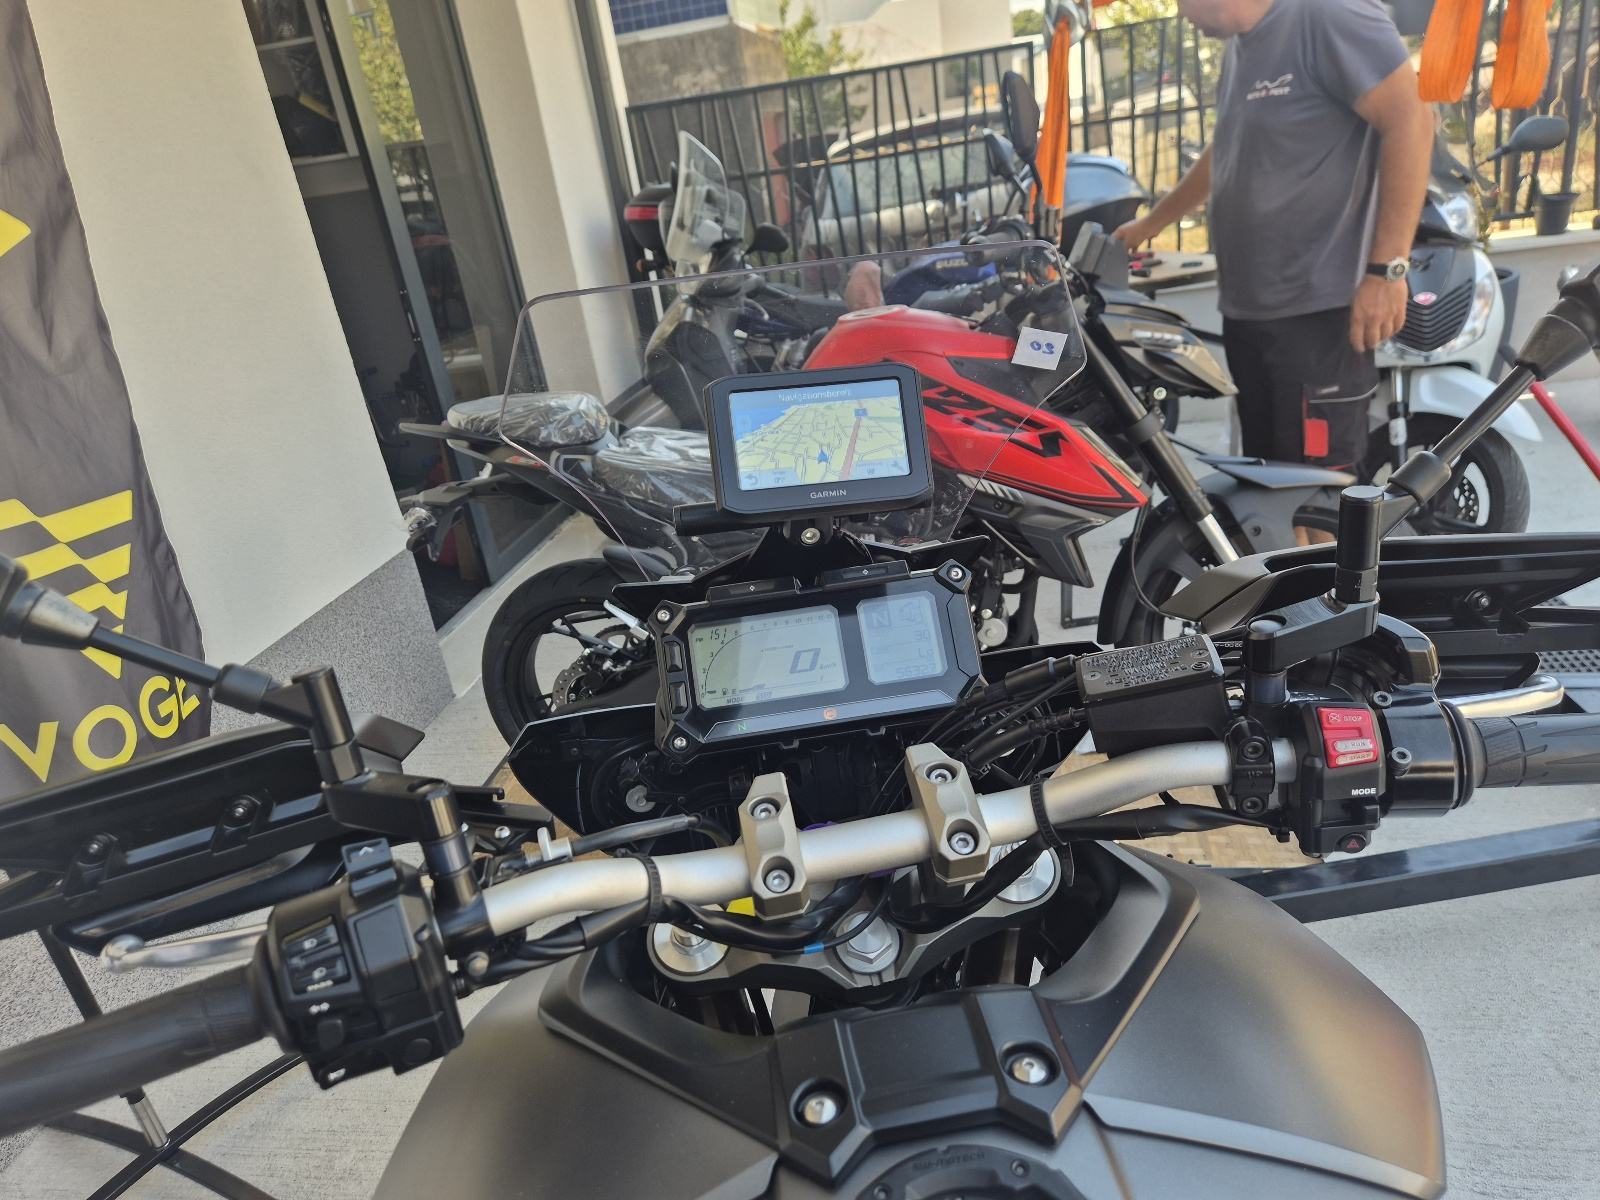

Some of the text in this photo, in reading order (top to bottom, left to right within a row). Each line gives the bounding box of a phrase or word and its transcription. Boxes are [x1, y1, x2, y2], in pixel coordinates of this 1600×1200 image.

[809, 488, 847, 499] GARMIN
[789, 648, 821, 673] 0
[1343, 714, 1363, 723] STOP
[1351, 787, 1377, 796] MODE
